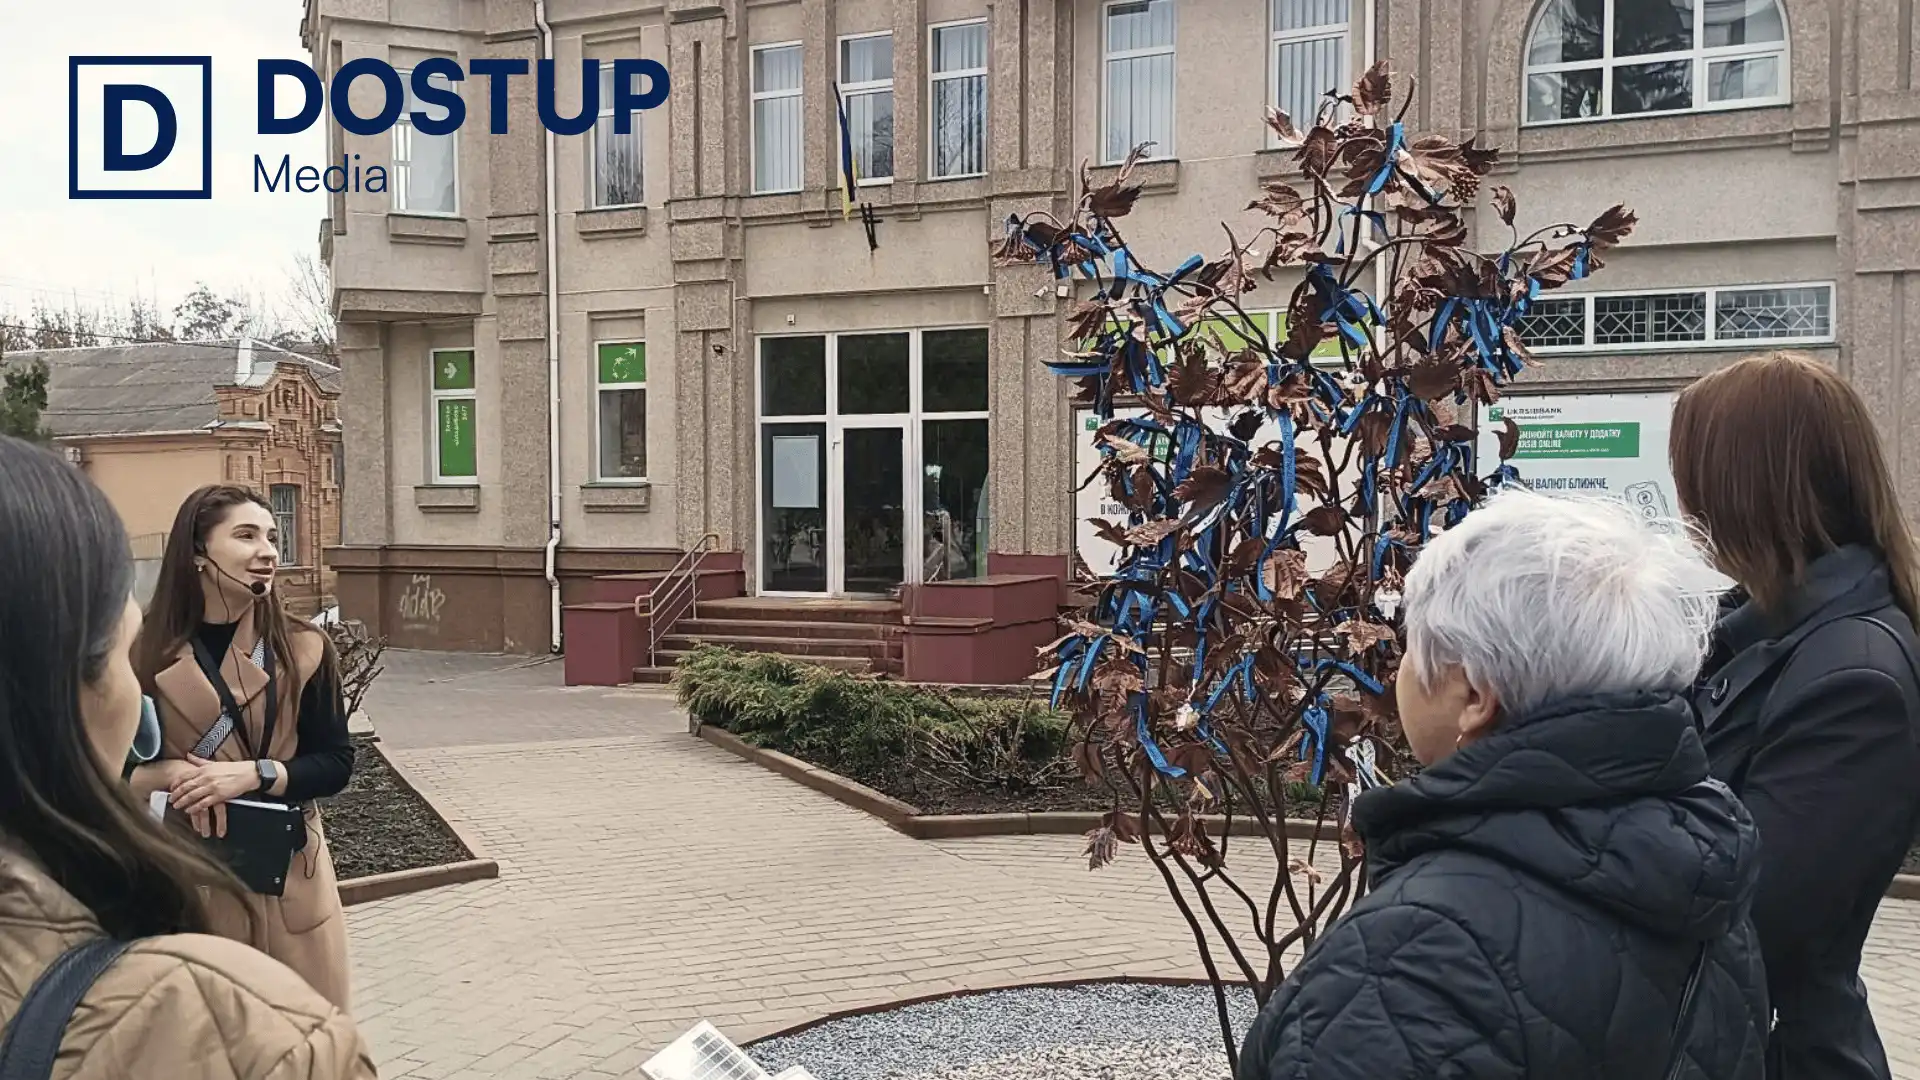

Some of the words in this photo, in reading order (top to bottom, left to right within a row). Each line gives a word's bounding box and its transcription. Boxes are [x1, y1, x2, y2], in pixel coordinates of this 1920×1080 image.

[1507, 407, 1562, 415] UKRSIBBANK
[1555, 429, 1583, 439] ВАЛЮТУ
[1584, 429, 1590, 438] У
[1590, 428, 1621, 439] ДОДАТКУ
[1517, 439, 1537, 448] KRSIB
[1538, 438, 1562, 448] ONLINE
[1535, 478, 1567, 489] ВАЛЮТ
